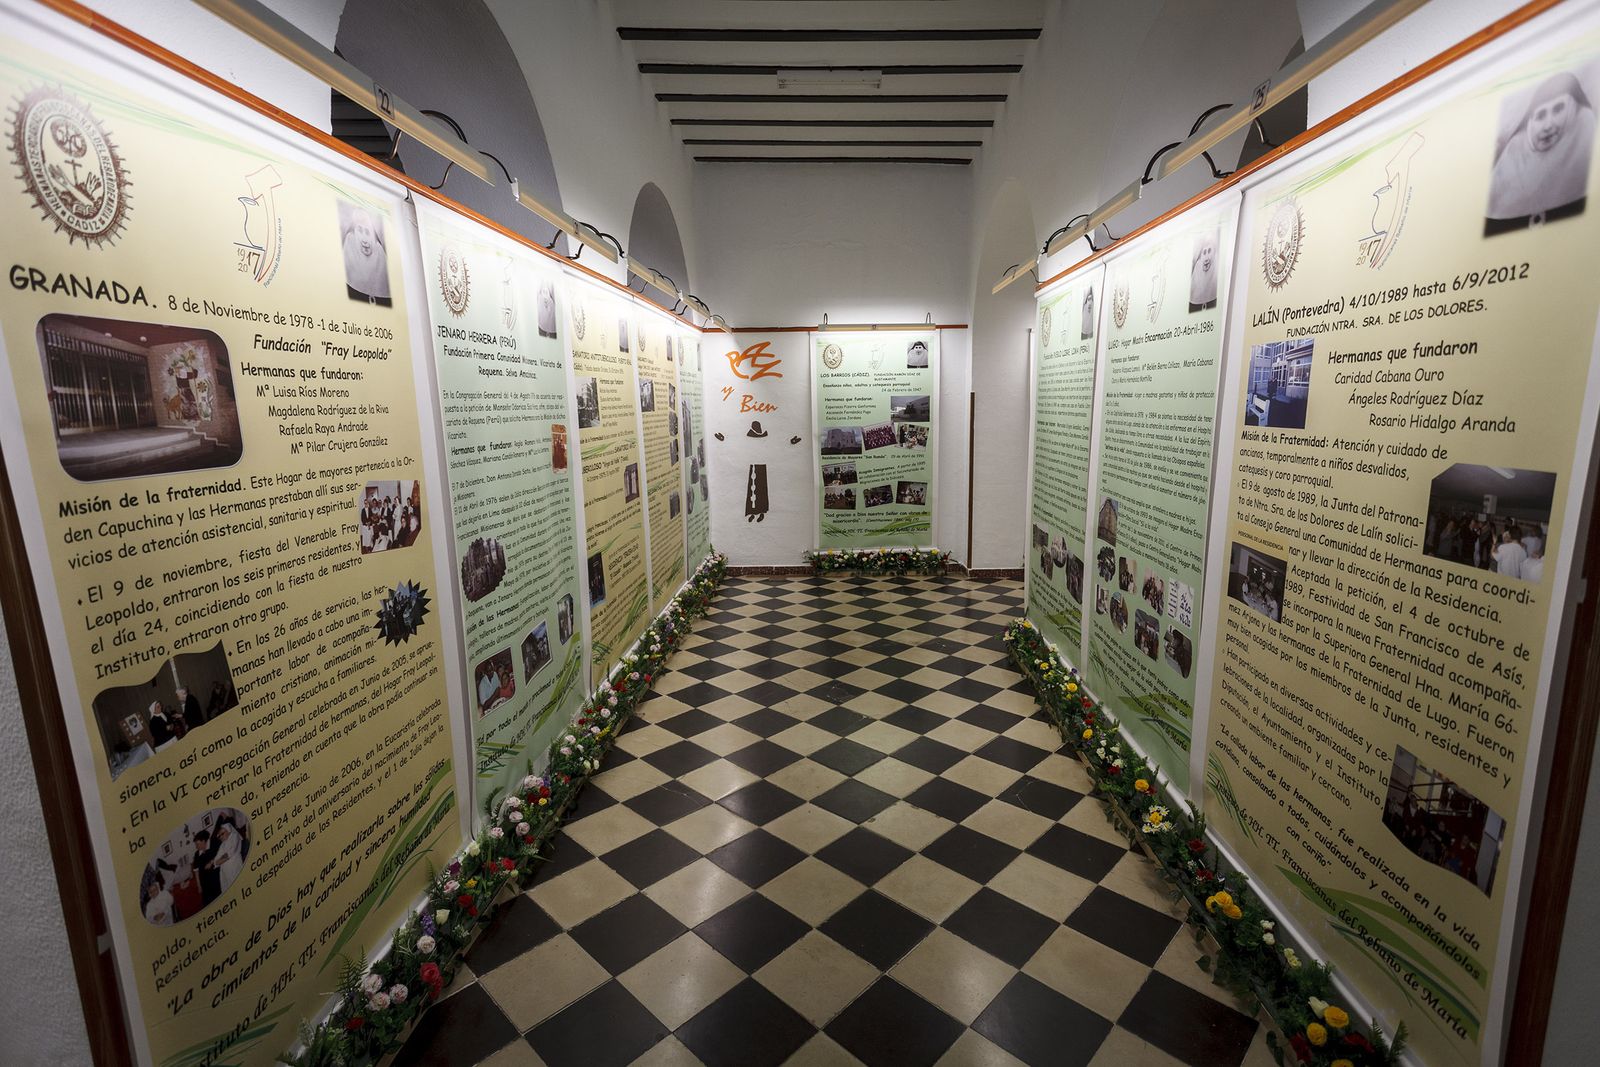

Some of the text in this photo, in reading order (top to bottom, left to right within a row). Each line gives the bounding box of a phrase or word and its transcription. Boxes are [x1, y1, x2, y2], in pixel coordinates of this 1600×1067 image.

[9, 264, 157, 308] GRANADA.
[168, 295, 178, 311] 8
[182, 297, 200, 314] de
[203, 300, 270, 323] Noviembre
[273, 311, 287, 325] de
[289, 314, 314, 329] 1978
[328, 320, 340, 332] de
[342, 322, 362, 336] Julio
[364, 326, 373, 337] de
[374, 327, 393, 340] 2006
[1252, 262, 1530, 328] LALÍN (Pontevedra) 4/10/1989 hasta 6/9/2012
[1286, 299, 1487, 338] FUNDACIÓN NTRA. SRA. DE LOS DOLORES.
[254, 334, 311, 354] Fundación
[438, 325, 466, 340] JENARO
[469, 331, 497, 345] HERRERA
[1328, 340, 1478, 364] Hermanas que fundaron
[241, 362, 363, 382] Hermanas que fundaron:
[1334, 368, 1444, 384] Caridad Cabana Ouro
[272, 385, 297, 398] Luisa
[298, 385, 317, 398] Ríos
[320, 387, 350, 398] Moreno
[1348, 388, 1484, 409] Ángeles Rodríguez Díaz
[268, 405, 316, 420] Magdalena
[317, 404, 357, 418] Rodríguez
[358, 404, 368, 415] de
[375, 404, 389, 414] Riva
[740, 395, 778, 413] Bien
[279, 421, 369, 436] Rafaela Raya Andrade
[1369, 413, 1516, 434] Rosario Hidalgo Aranda
[306, 441, 326, 452] Pilar
[328, 439, 358, 453] Crujera
[359, 436, 388, 448] González
[1241, 430, 1260, 441] Misión
[1261, 432, 1269, 443] de
[1280, 433, 1329, 448] Fraternidad:
[1332, 438, 1375, 453] Atención
[1378, 444, 1384, 457] y
[1386, 442, 1428, 458] cuidado
[1431, 444, 1448, 460] de
[59, 496, 112, 518] Misión
[119, 492, 139, 508] de
[146, 490, 160, 504] la
[166, 478, 246, 502] fraternidad.
[250, 476, 274, 489] Este
[276, 473, 303, 486] Hogar
[306, 469, 317, 480] de
[319, 466, 353, 480] mayores
[355, 459, 389, 476] pertenecía
[94, 601, 288, 680] Instituto, entraron otro grupo.
[1286, 826, 1300, 842] con
[1282, 849, 1336, 911] Franciscanas
[1420, 988, 1468, 1040] María
[155, 932, 229, 993] Residencia.
